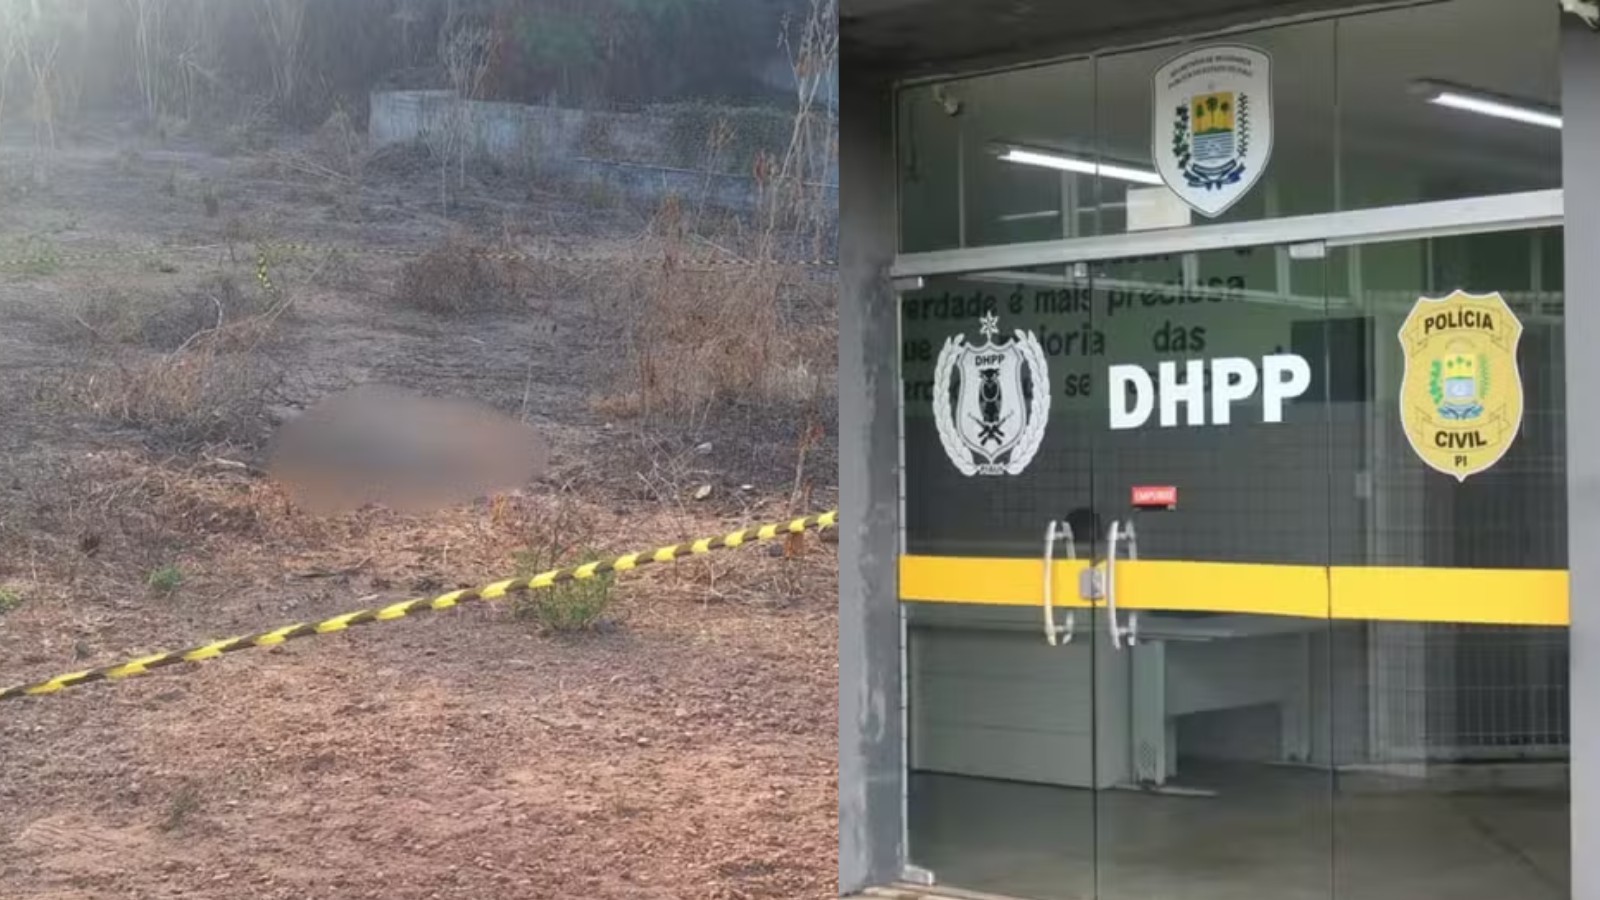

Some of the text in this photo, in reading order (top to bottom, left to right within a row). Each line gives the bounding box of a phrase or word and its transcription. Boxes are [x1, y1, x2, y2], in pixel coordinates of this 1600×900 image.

[1036, 285, 1092, 314] mais
[1425, 306, 1494, 335] POLÍCIA
[902, 337, 932, 361] ue
[1153, 320, 1205, 353] das
[975, 354, 1005, 366] DHPP
[1108, 353, 1312, 430] DHPP
[1435, 431, 1488, 449] CIVIL
[1455, 455, 1468, 468] PI
